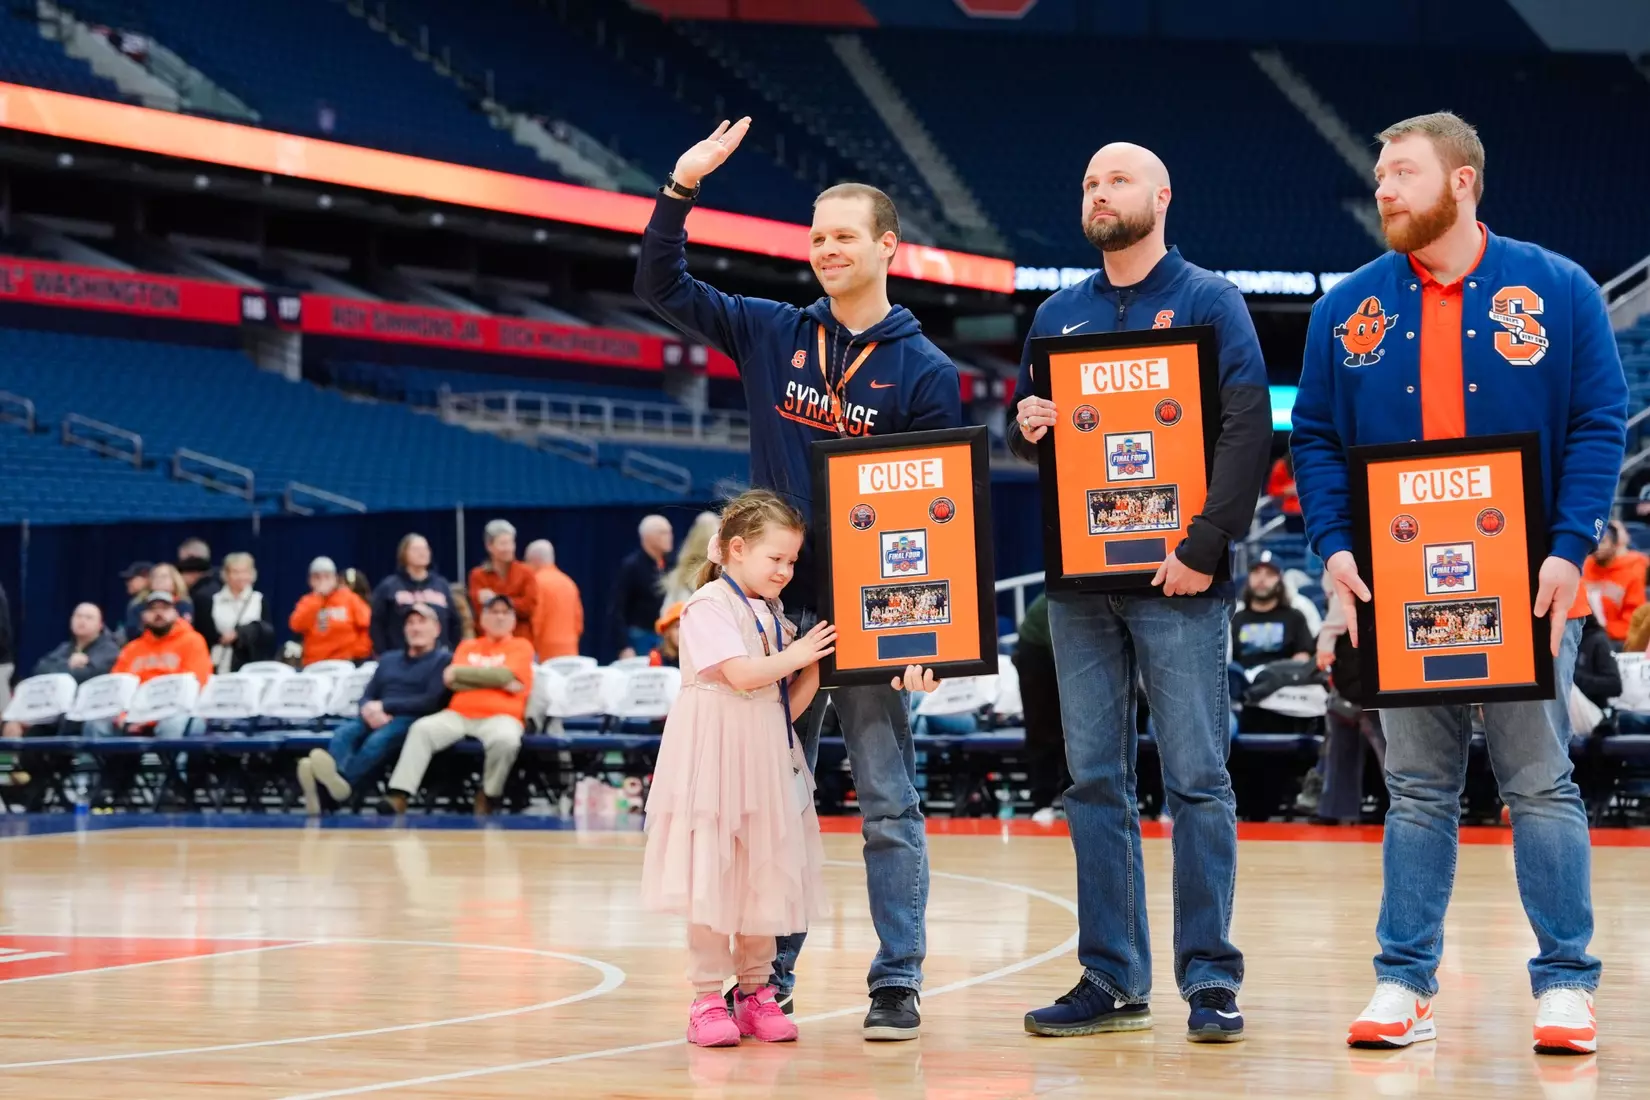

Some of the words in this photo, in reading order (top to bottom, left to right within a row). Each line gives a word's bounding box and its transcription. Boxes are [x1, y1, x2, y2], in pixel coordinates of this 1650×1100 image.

[31, 269, 180, 311] WASHINGTON
[1152, 309, 1175, 330] S
[1493, 314, 1519, 324] OCTOBER'S
[790, 349, 807, 369] S
[1084, 360, 1161, 392] 'CUSE
[784, 380, 878, 437] SYRAUSE
[1113, 455, 1130, 463] FINAL
[861, 460, 936, 491] 'CUSE
[1403, 467, 1483, 501] 'CUSE
[888, 552, 905, 561] FINAL
[905, 551, 921, 560] FOUR
[1433, 566, 1450, 574] FINAL
[1450, 565, 1468, 573] FOUR
